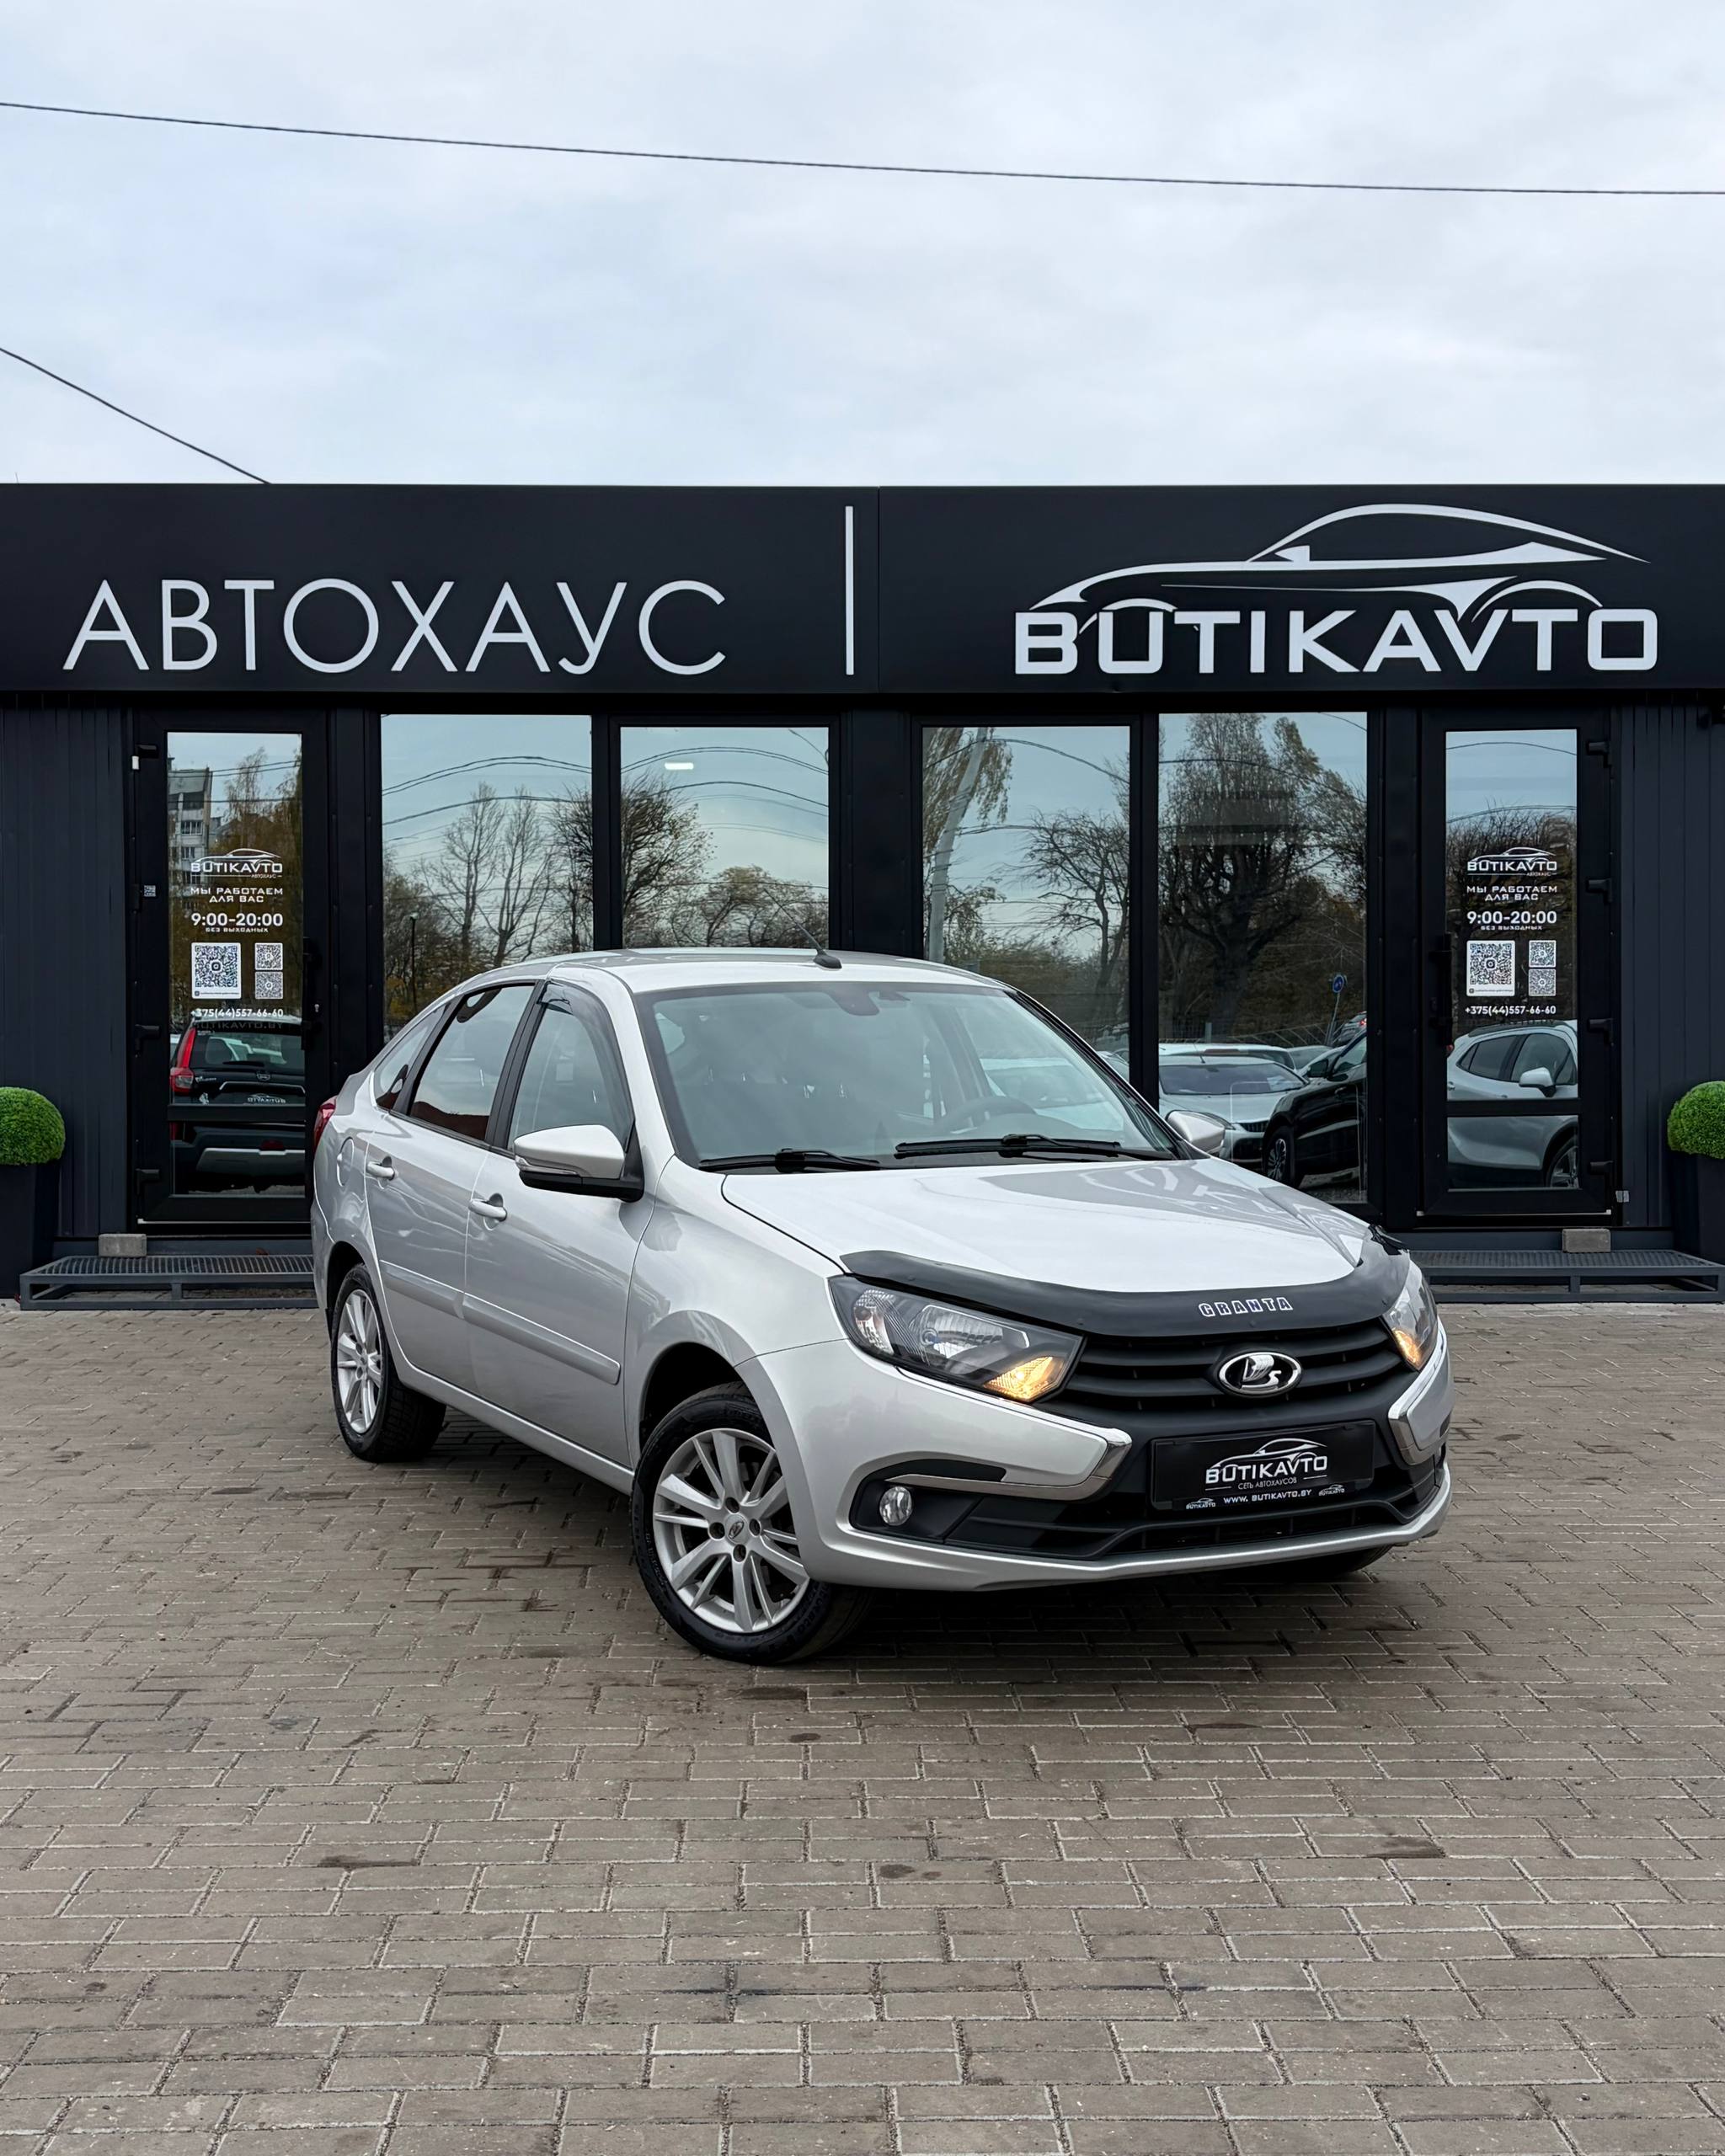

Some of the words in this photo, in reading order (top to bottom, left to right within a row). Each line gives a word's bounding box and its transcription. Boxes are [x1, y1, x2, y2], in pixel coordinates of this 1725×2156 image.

[62, 578, 726, 675] АВТОХАУС
[1015, 608, 1658, 675] BUTIKAVTO
[190, 862, 283, 873] BUTIKAVTO
[1466, 861, 1557, 872] BUTIKAVTO
[190, 887, 211, 895] МЫ
[216, 887, 283, 895] РАБОТАЕМ
[1466, 885, 1487, 894] МЫ
[1492, 885, 1557, 894] РАБОТАЕМ
[190, 912, 283, 926] 9:00-20:00
[1466, 910, 1557, 924] 9:00-20:00
[190, 1008, 284, 1018] +375(44)557-66-60
[1465, 1006, 1557, 1017] +375(44)557-66-60
[1199, 1297, 1294, 1317] GRANTA
[1205, 1455, 1328, 1484] BUTIKAVTO
[1255, 1477, 1297, 1488] АВТОХАУСОВ
[1223, 1495, 1249, 1504] WWW.
[1252, 1489, 1312, 1502] BUTIKAVTO.BY
